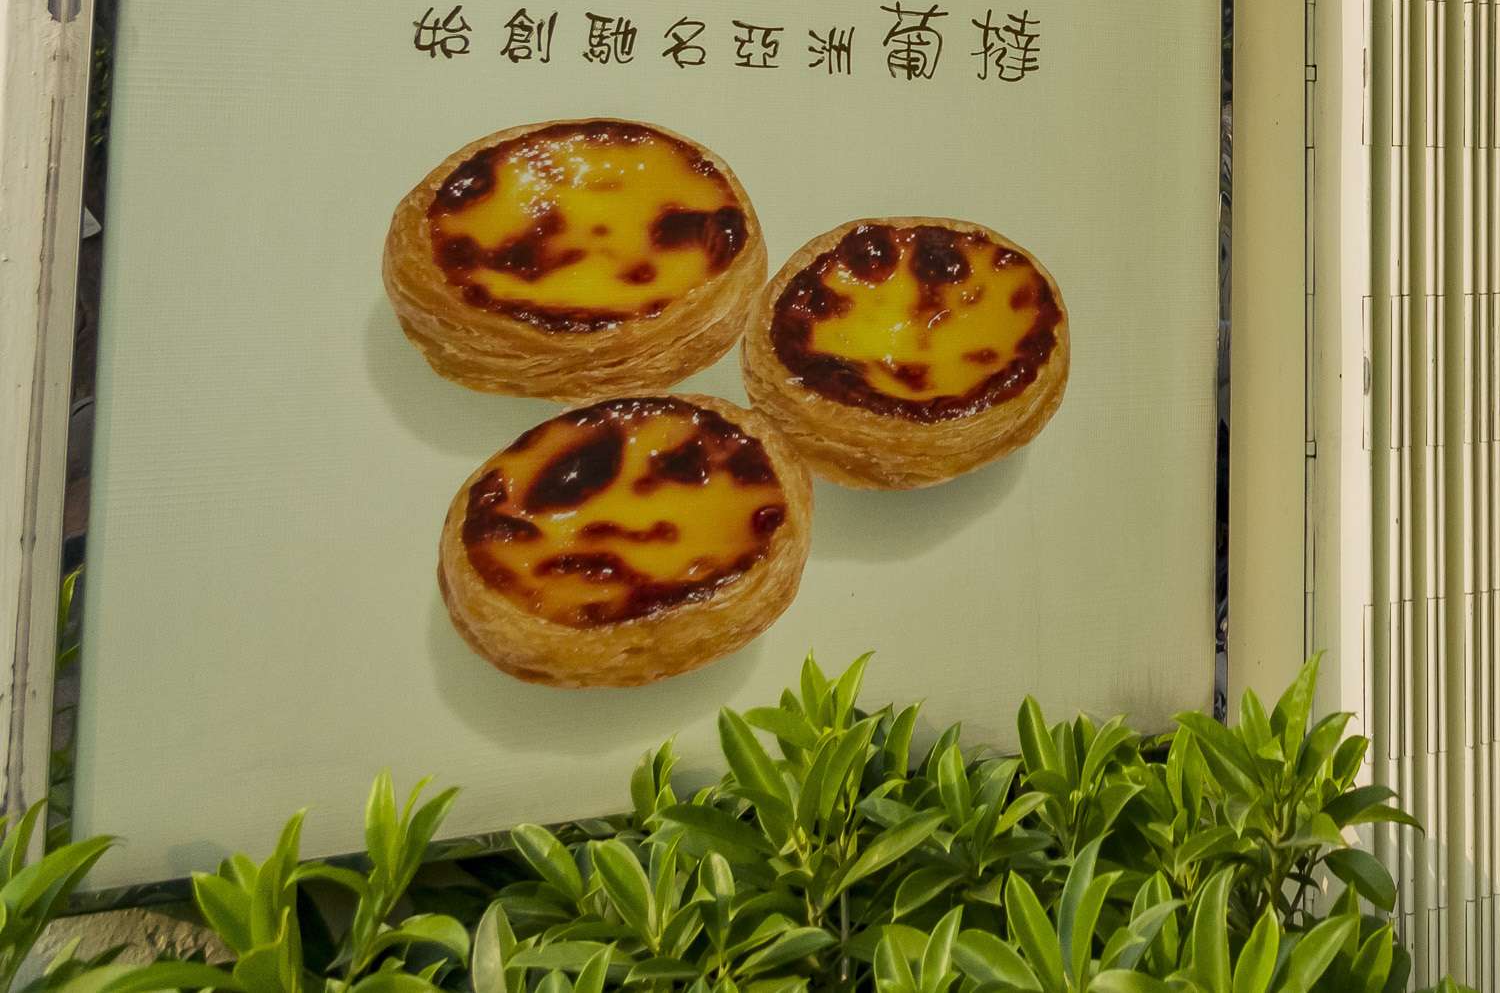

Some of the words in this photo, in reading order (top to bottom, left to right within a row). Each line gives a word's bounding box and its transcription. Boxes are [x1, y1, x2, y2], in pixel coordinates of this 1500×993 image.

[412, 0, 1042, 83] 始創馳名亞洲葡撻
